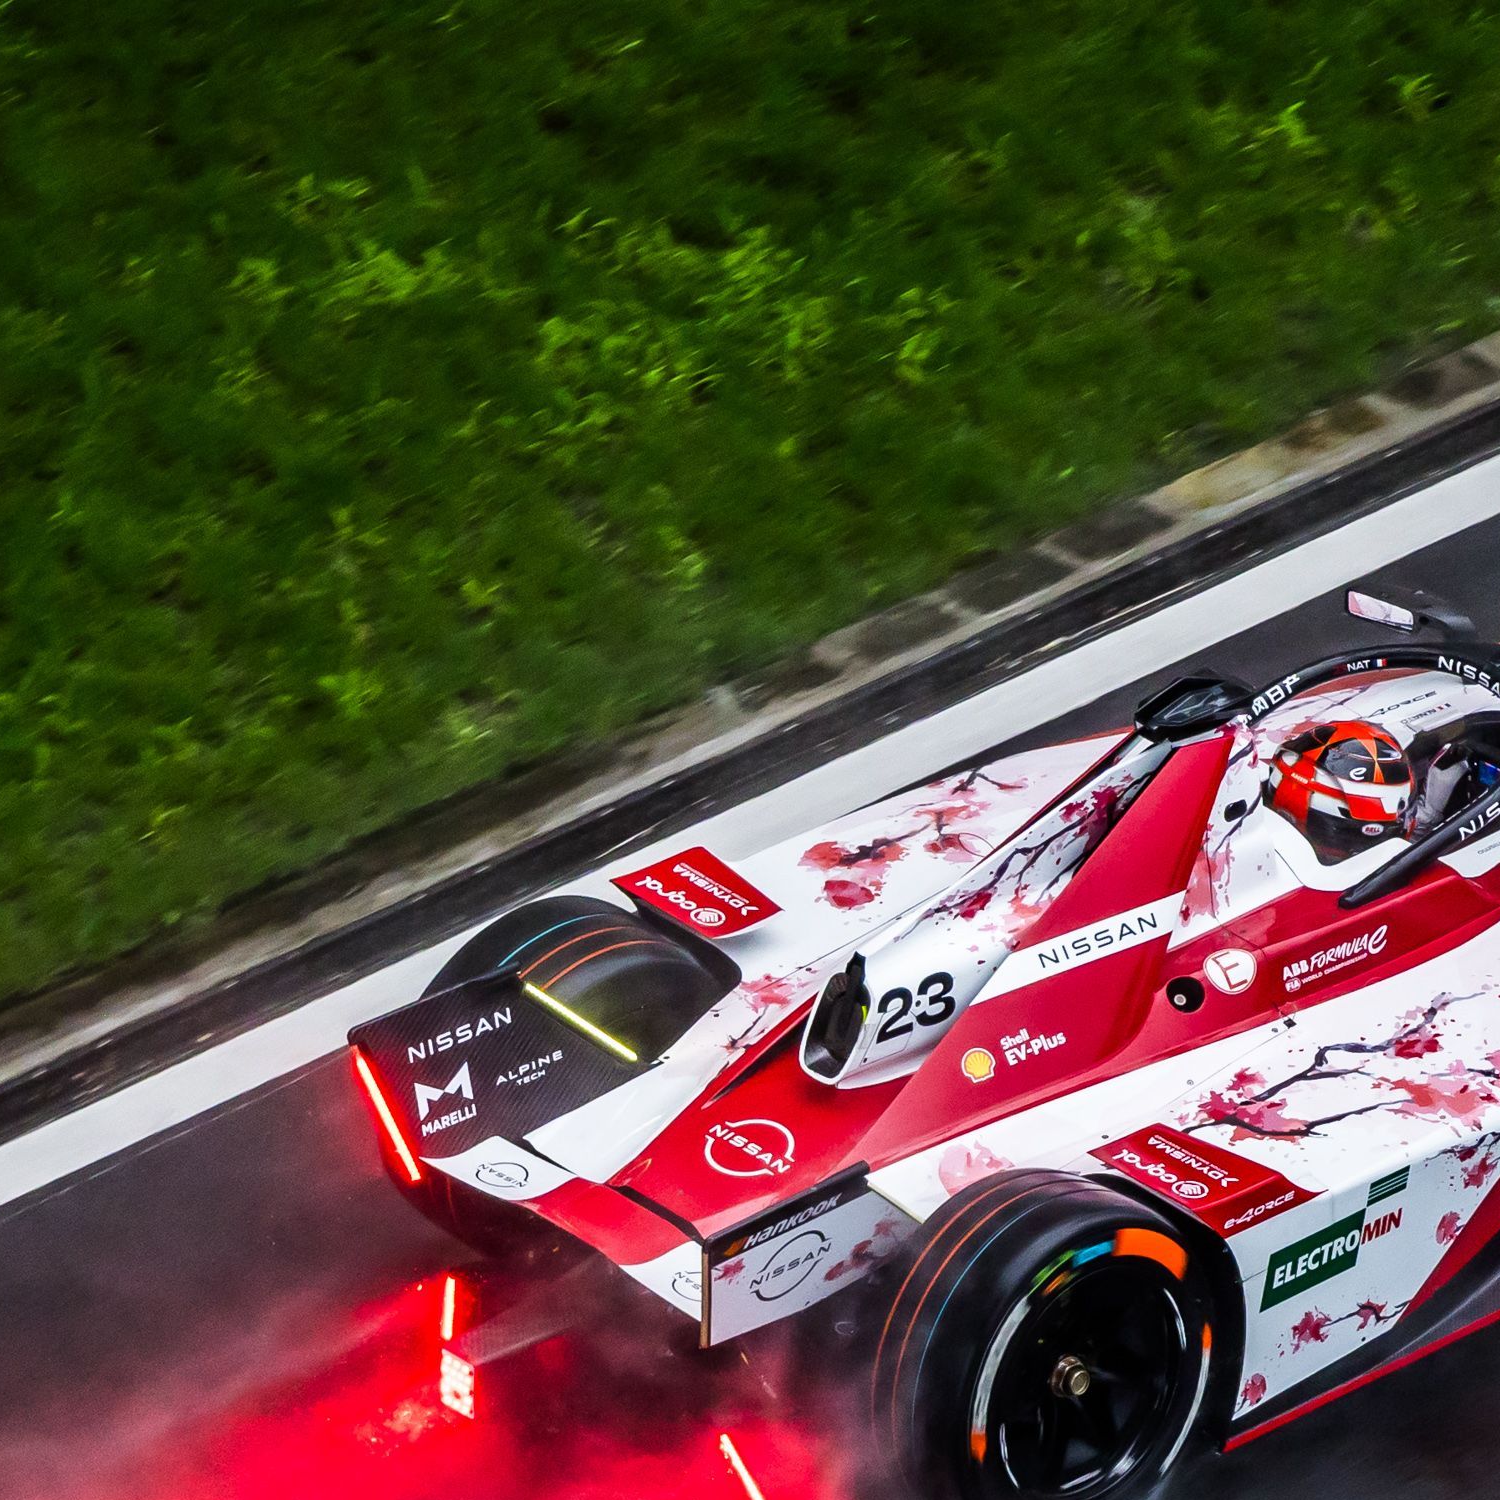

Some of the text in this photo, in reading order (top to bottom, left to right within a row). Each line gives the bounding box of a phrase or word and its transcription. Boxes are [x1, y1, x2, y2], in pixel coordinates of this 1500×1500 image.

[1347, 659, 1371, 672] NAT
[672, 864, 745, 909] DYNISMA
[1038, 911, 1159, 970] NISSAN
[1282, 959, 1310, 981] ABB
[875, 971, 957, 1044] 23
[407, 1007, 513, 1064] NISSAN
[1000, 1028, 1031, 1051] Shell
[1004, 1030, 1068, 1067] EV-Plus
[496, 1049, 563, 1087] ALPINE
[515, 1070, 546, 1086] TECH
[421, 1103, 477, 1137] MARELLI
[708, 1123, 791, 1174] NISSAN
[1148, 1136, 1223, 1182] DYNISMA
[478, 1163, 527, 1188] NISSAN
[749, 1241, 833, 1290] NISSAN
[1272, 1207, 1403, 1290] ELECTROMIN
